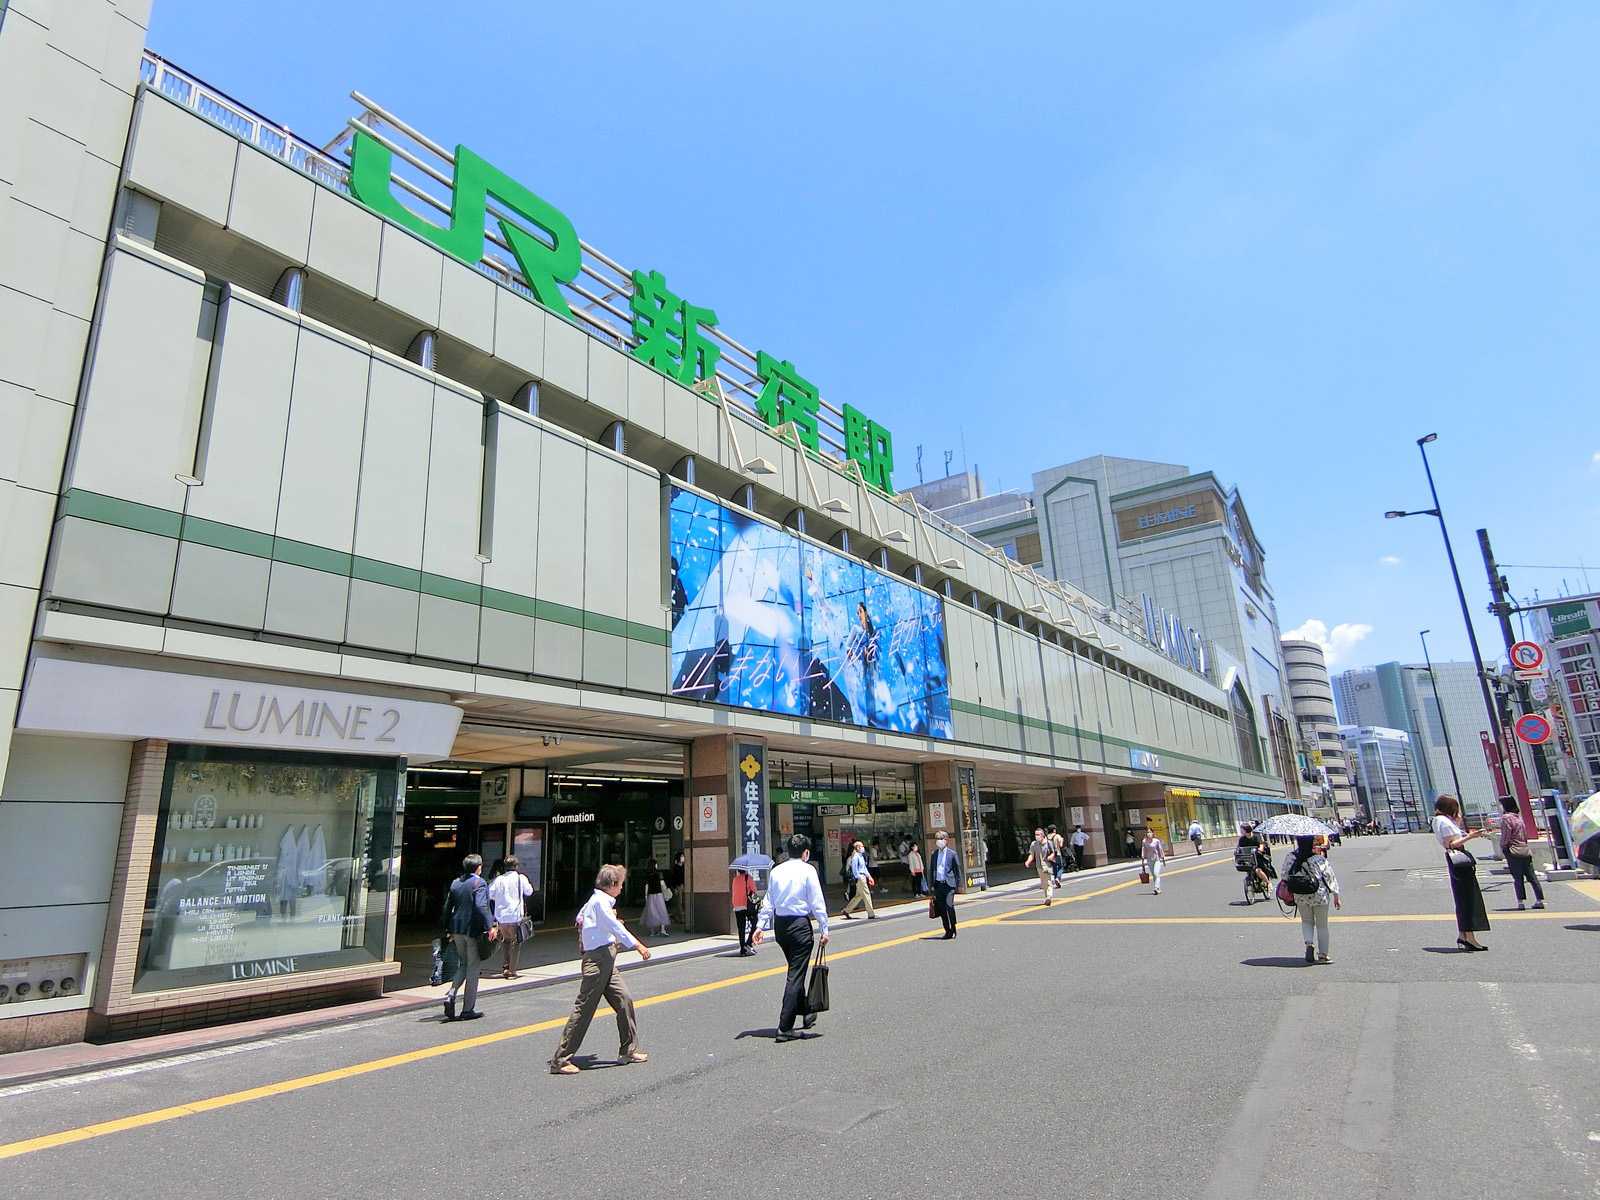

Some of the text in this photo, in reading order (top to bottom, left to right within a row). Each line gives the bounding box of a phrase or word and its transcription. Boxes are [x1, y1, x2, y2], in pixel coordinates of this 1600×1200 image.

[350, 132, 582, 322] JR
[631, 269, 894, 497] 新宿駅
[1138, 504, 1197, 529] LUMINE
[204, 689, 400, 743] LUMINE 2
[552, 811, 595, 824] nformation
[179, 893, 266, 908] BALANCE IN MOTION
[318, 913, 341, 923] PLANT
[231, 956, 299, 979] LUMINE
